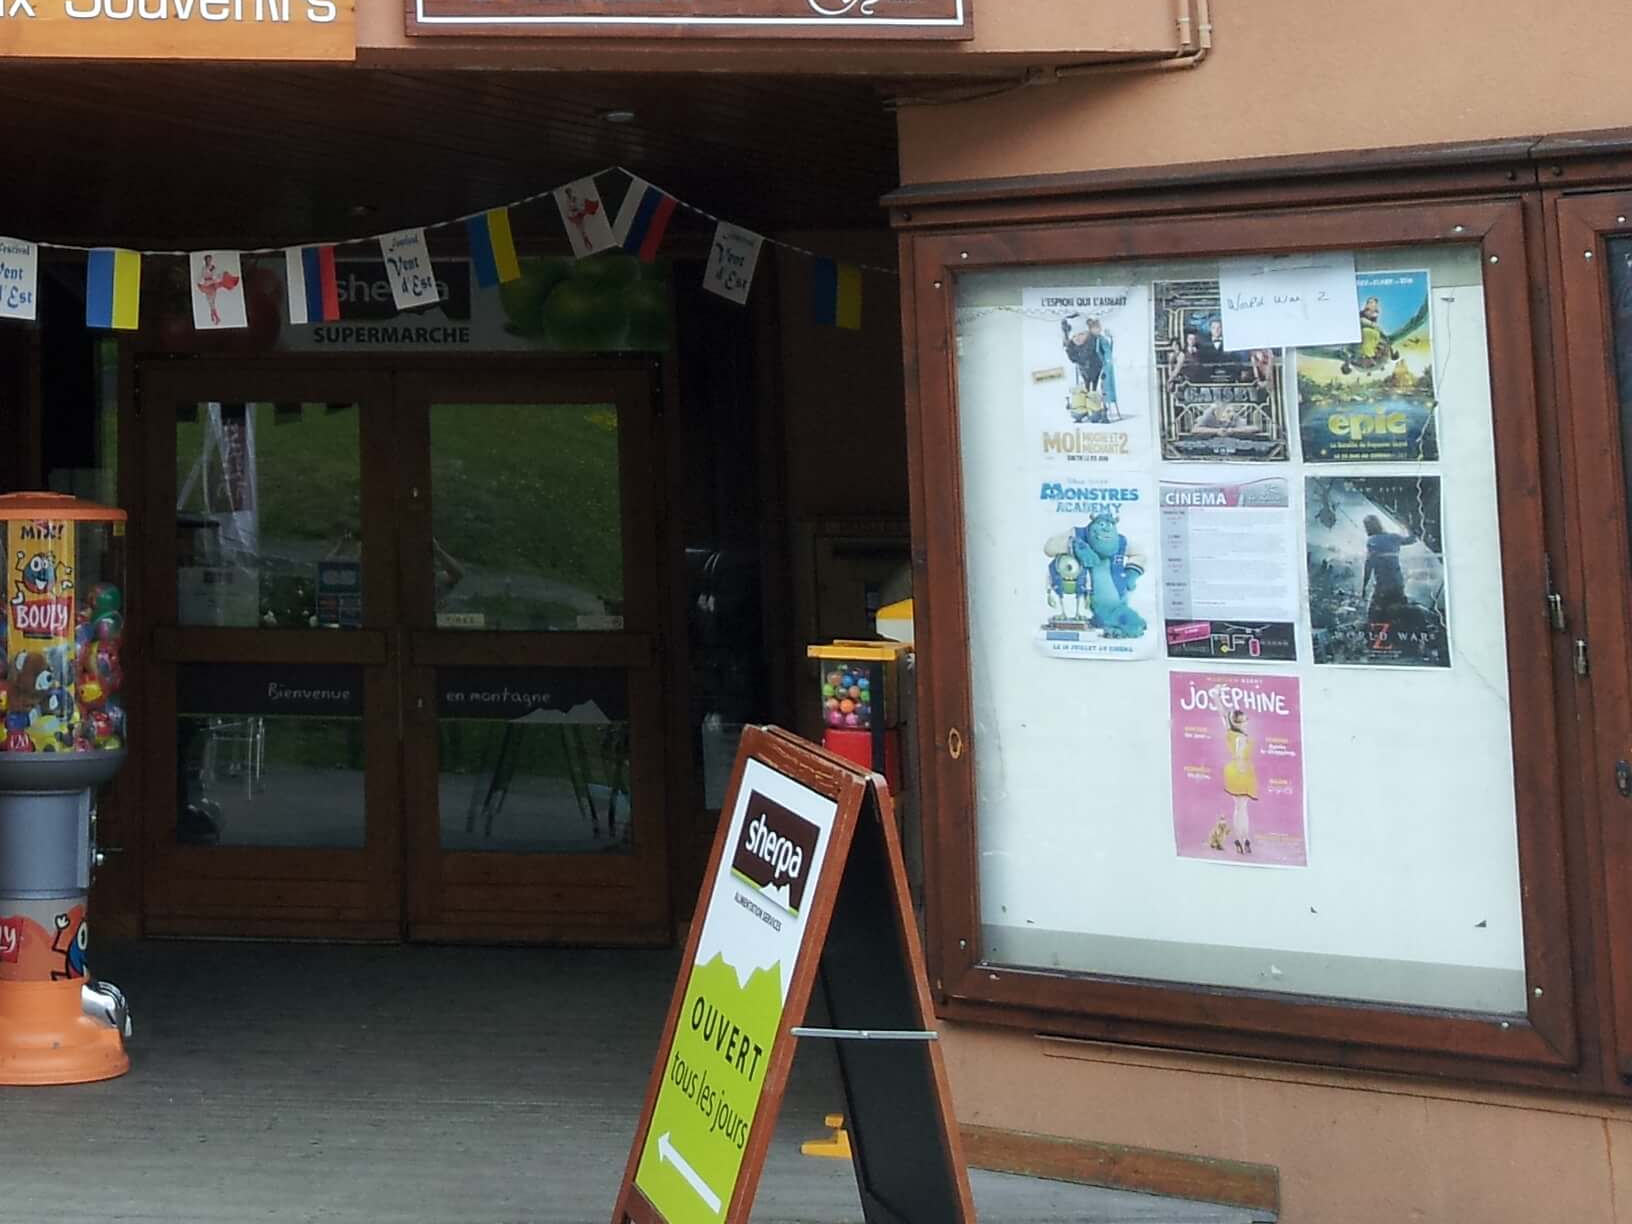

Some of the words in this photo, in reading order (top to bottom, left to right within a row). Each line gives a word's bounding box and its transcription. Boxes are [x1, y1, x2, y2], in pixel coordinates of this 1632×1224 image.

[337, 274, 449, 303] shea
[313, 327, 470, 344] SUPERMARCHE
[1040, 482, 1140, 501] MONSTRES
[1165, 492, 1227, 505] CINEMA
[16, 601, 69, 630] BOULY
[267, 682, 352, 701] Bienvenue
[445, 690, 465, 703] en
[470, 688, 552, 707] montagne
[745, 813, 803, 879] sherpa
[691, 995, 763, 1083] OUVERT
[671, 1051, 698, 1099] tous
[695, 1069, 716, 1117] les
[709, 1089, 748, 1150] jours
